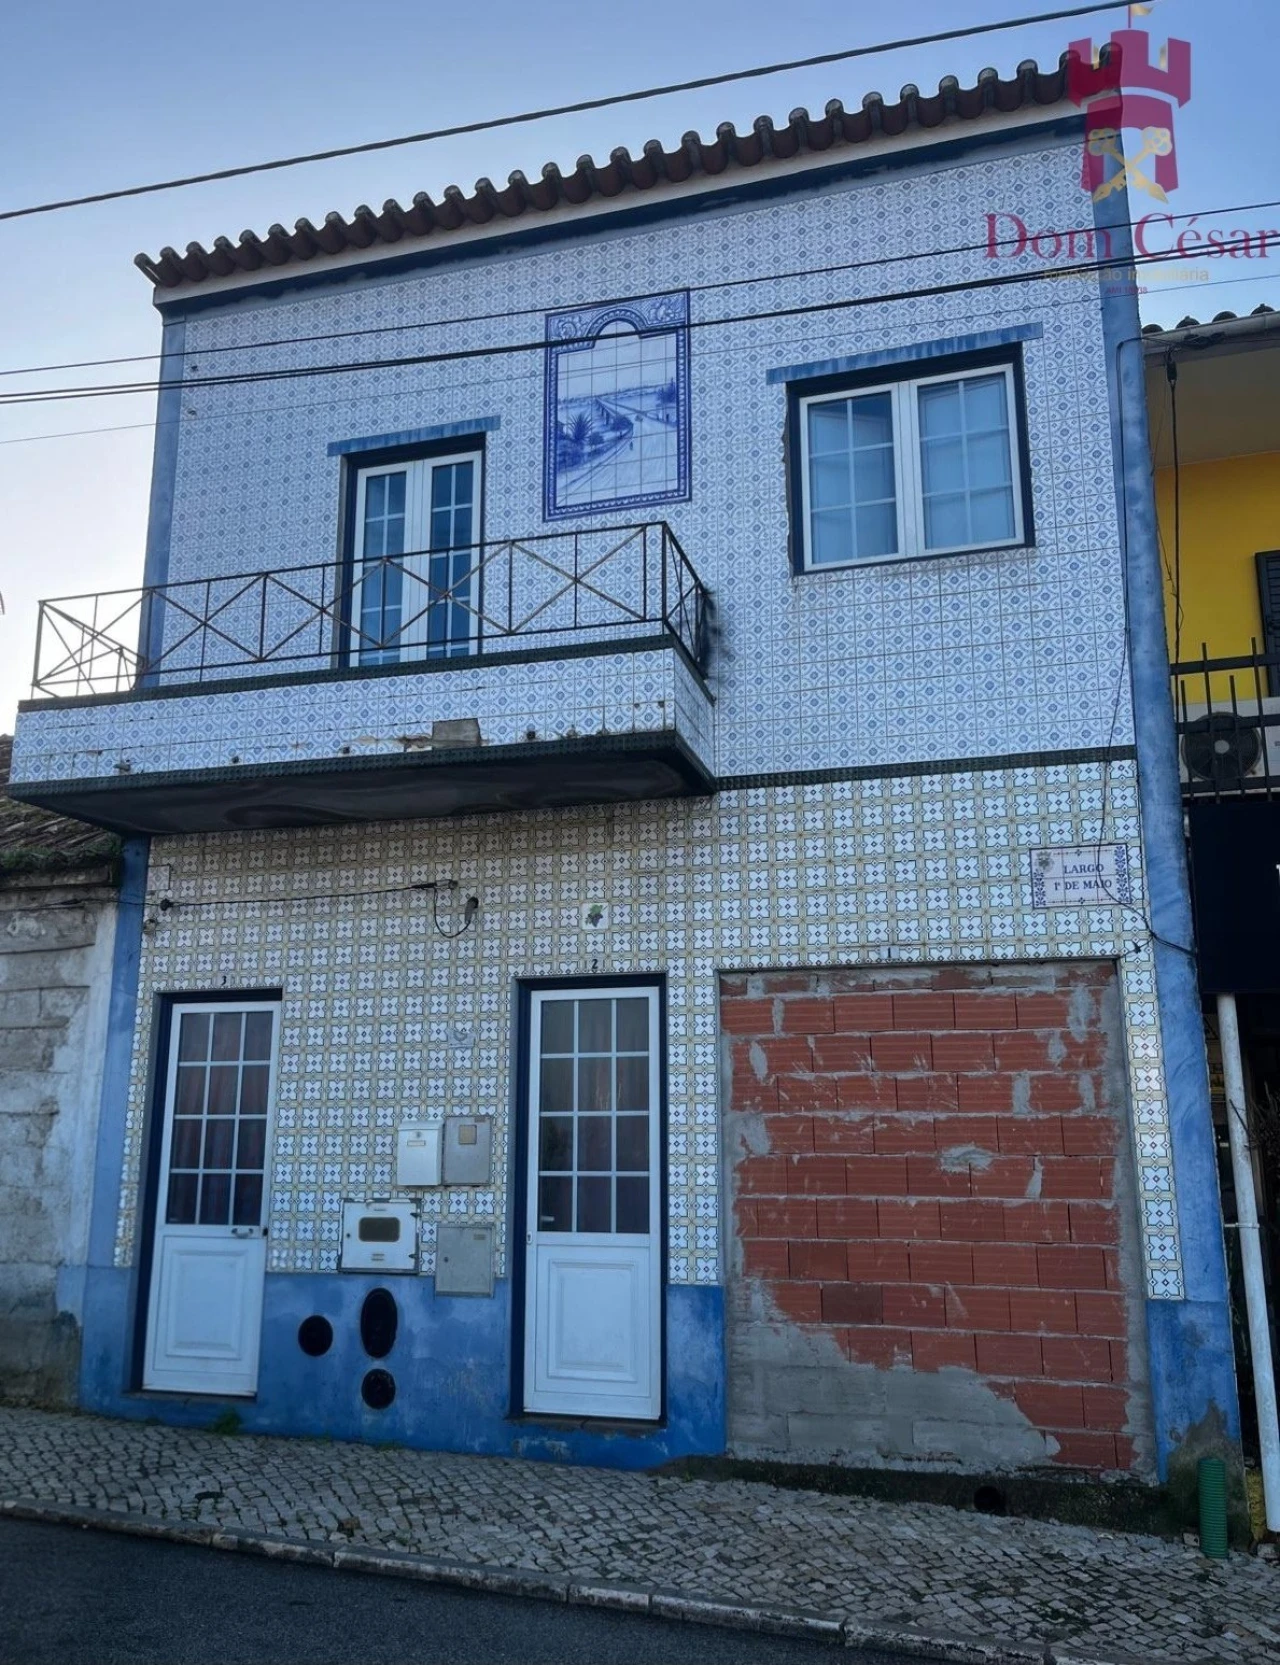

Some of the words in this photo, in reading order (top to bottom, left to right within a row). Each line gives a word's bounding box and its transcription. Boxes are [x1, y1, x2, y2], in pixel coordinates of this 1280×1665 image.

[1064, 864, 1105, 874] LARGO
[1065, 881, 1080, 890] DE
[1083, 879, 1112, 890] MAIO
[591, 958, 599, 970] 2
